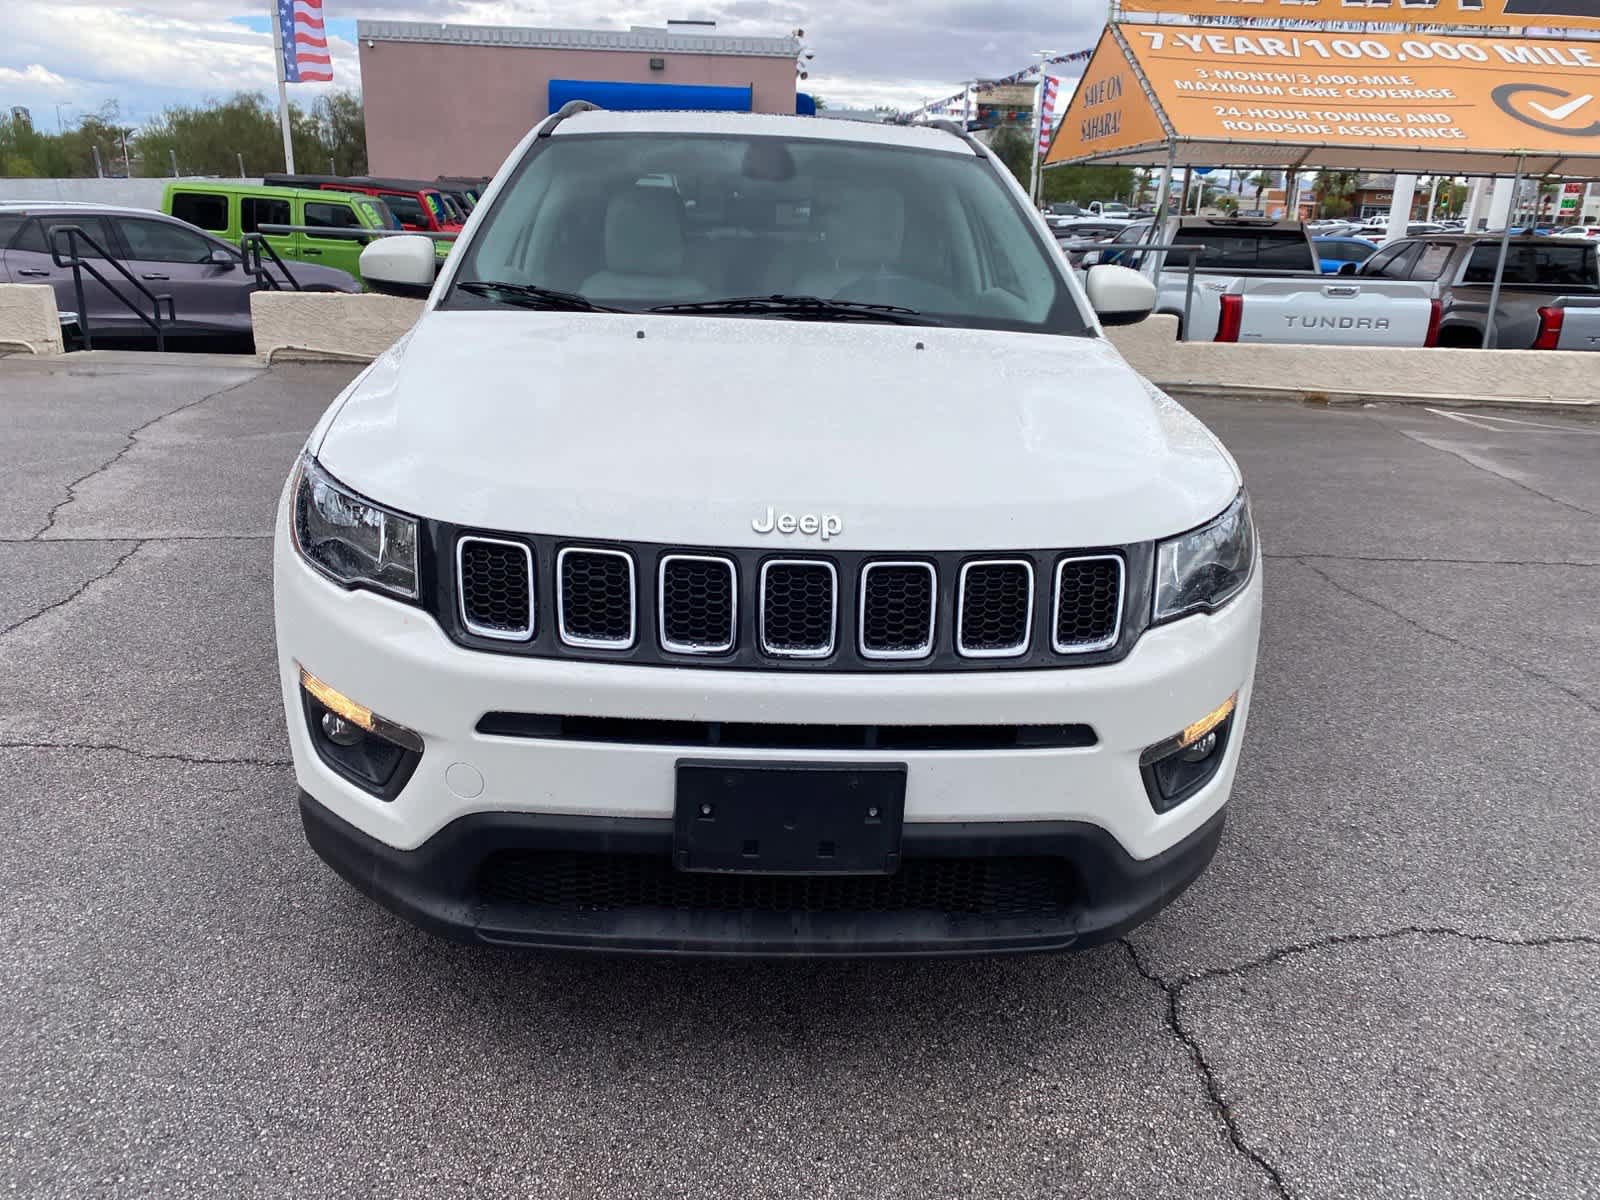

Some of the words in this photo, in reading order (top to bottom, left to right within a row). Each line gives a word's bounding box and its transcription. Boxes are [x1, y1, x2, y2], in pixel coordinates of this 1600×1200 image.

[1139, 31, 1488, 62] 7-YEAR/100,000
[1493, 44, 1600, 66] MILE
[1194, 68, 1414, 85] 3-MONTH/3,000-MILE
[1083, 80, 1105, 108] SAVE
[1107, 75, 1122, 100] ON
[1174, 79, 1283, 96] MAXIMUM
[1288, 86, 1342, 98] CARE
[1345, 88, 1457, 99] COVERAGE
[1213, 105, 1310, 120] 24-HOUR
[1311, 111, 1402, 123] TOWING
[1406, 112, 1452, 124] AND
[1080, 110, 1121, 142] SAHARA!
[1222, 119, 1334, 135] ROADSIDE
[1338, 125, 1467, 139] ASSISTANCE
[1284, 315, 1390, 330] TUNDRA
[751, 504, 843, 542] Jeep
